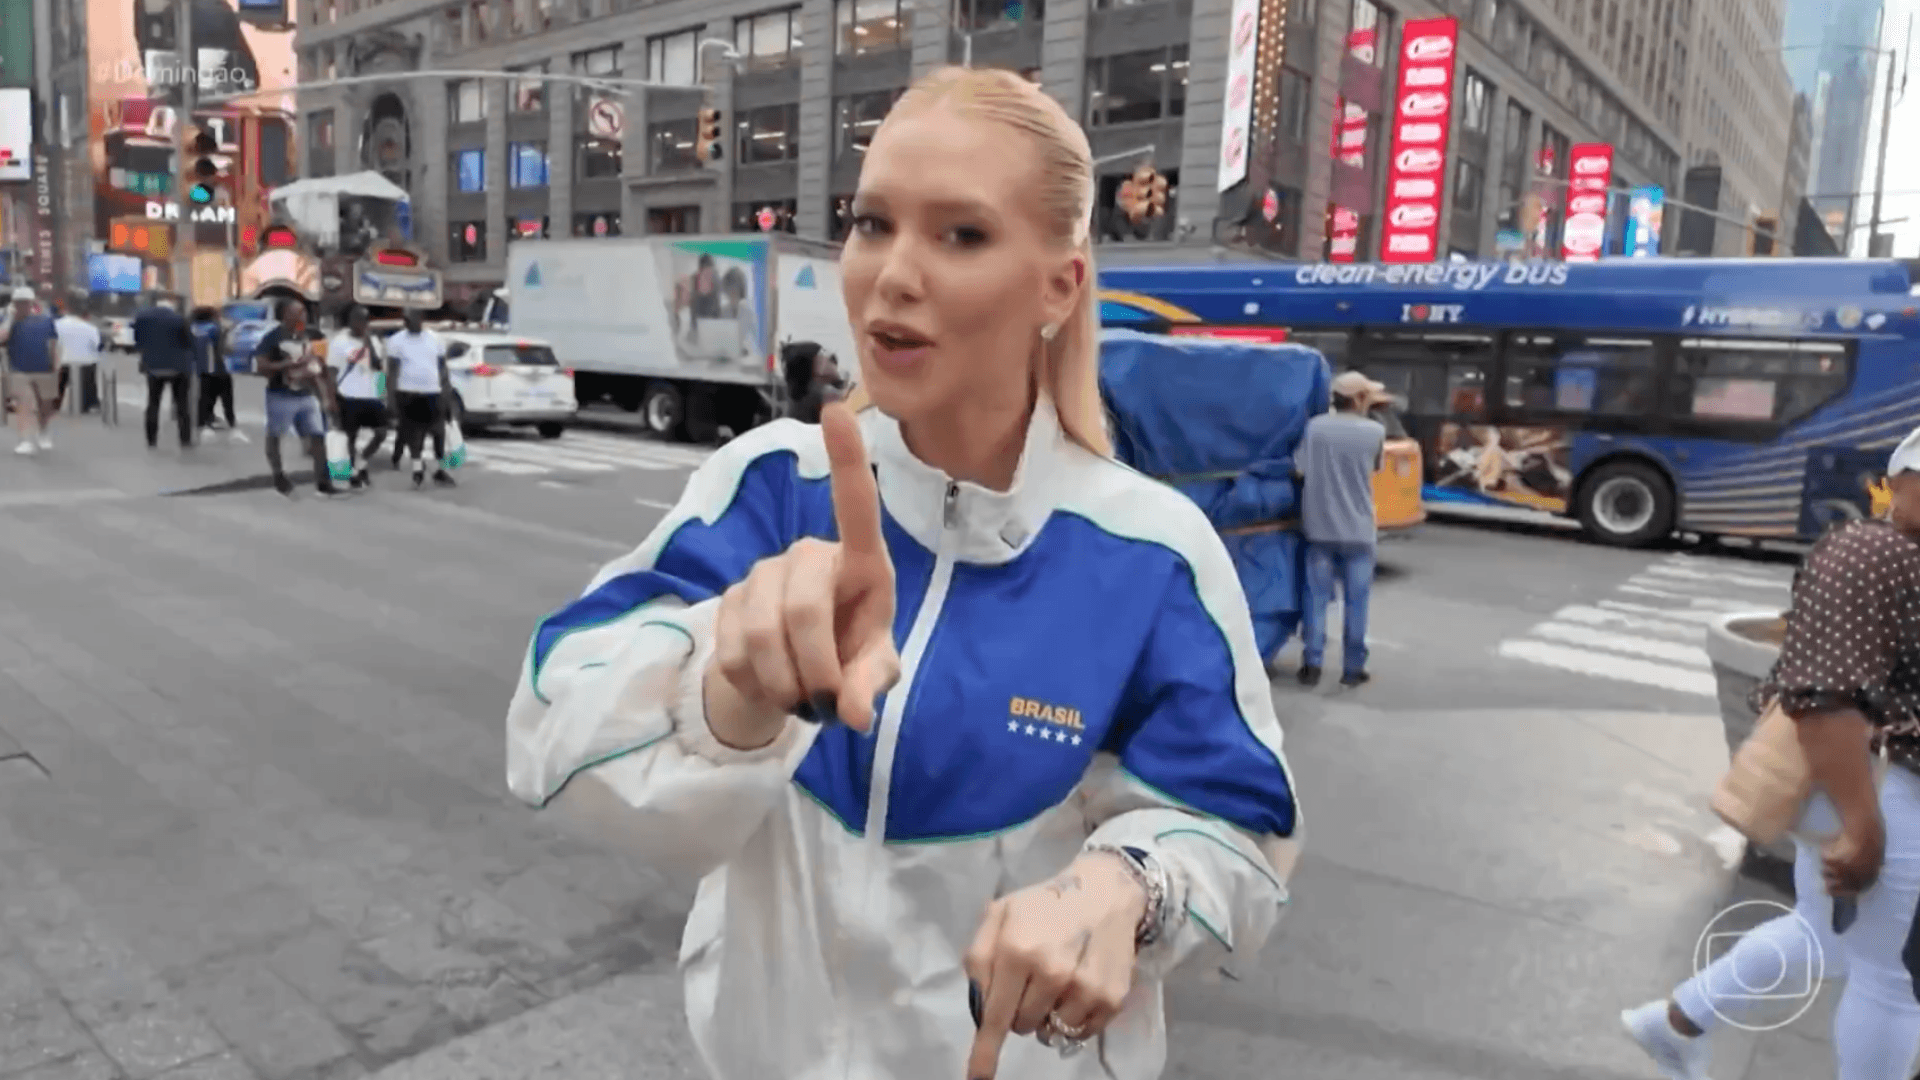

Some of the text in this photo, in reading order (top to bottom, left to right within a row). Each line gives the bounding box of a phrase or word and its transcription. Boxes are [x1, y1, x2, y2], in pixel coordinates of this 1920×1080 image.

[35, 155, 51, 216] SQUARE
[145, 200, 235, 223] DRAM
[1296, 261, 1570, 290] clean-energy bus
[1010, 697, 1085, 730] BRASIL
